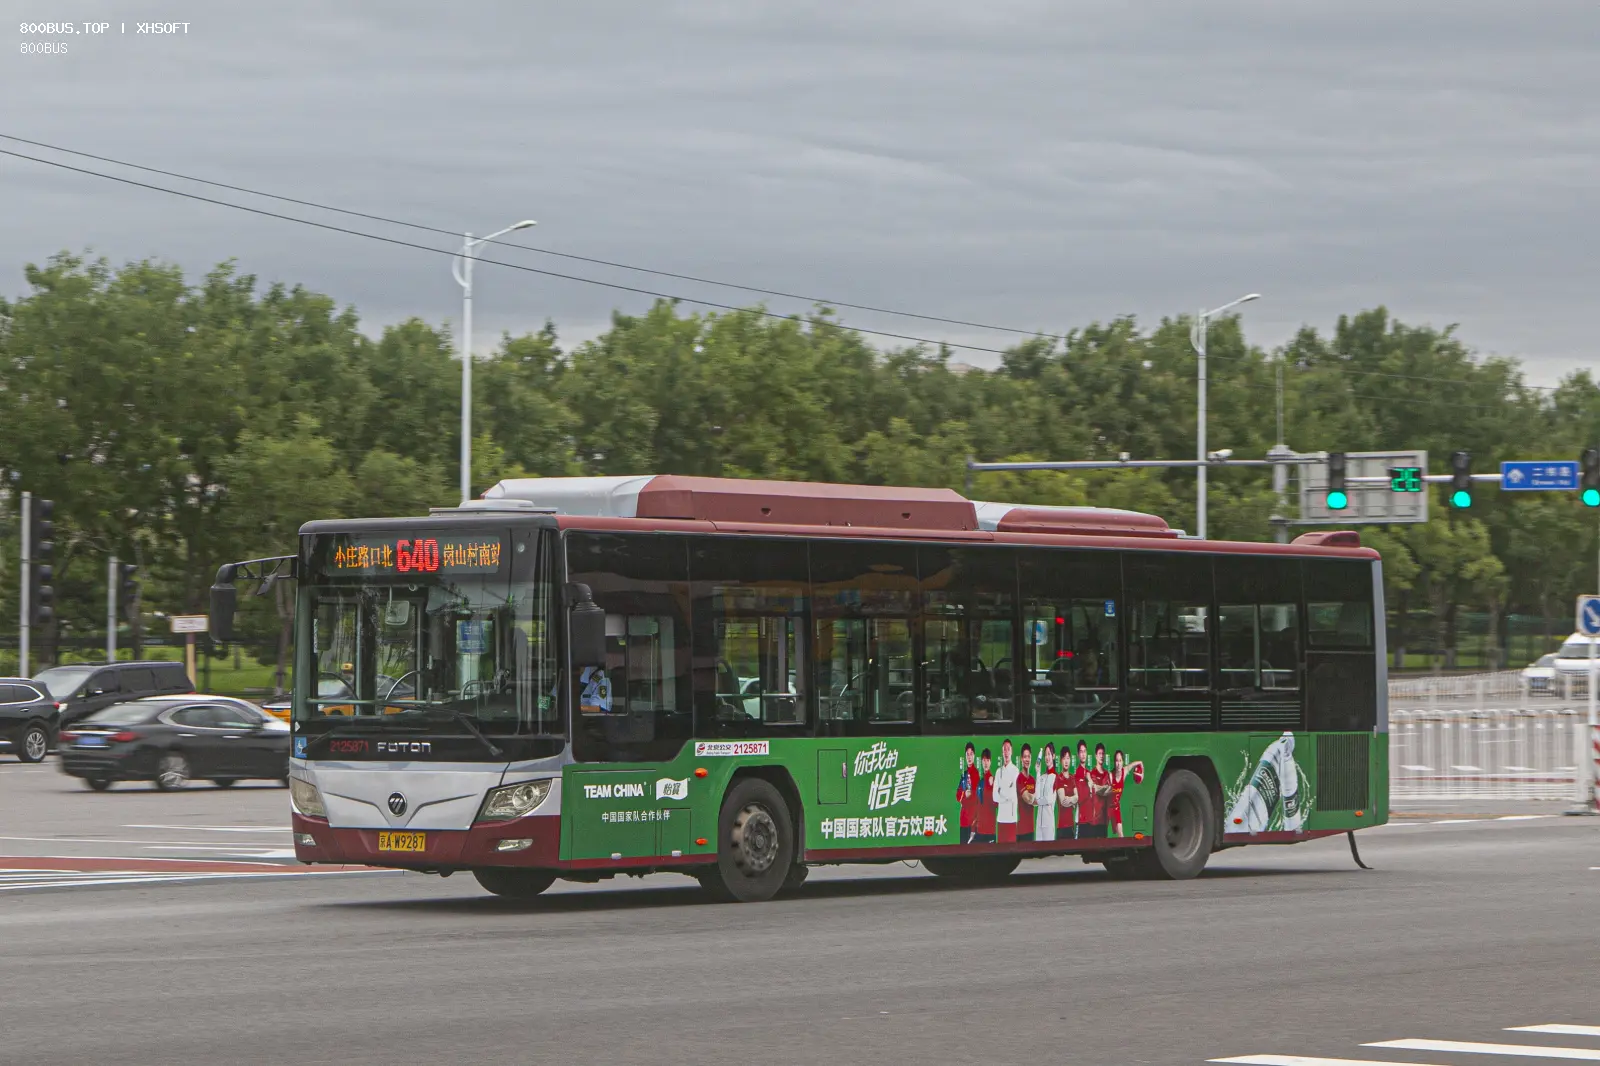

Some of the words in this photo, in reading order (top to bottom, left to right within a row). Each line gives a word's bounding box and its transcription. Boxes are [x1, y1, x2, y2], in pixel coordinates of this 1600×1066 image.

[396, 539, 439, 572] 640
[329, 740, 369, 753] 2125871
[377, 742, 431, 753] FOTON
[733, 743, 767, 754] 2125871
[853, 741, 899, 777] 你我的
[584, 784, 612, 798] TEAM
[613, 783, 644, 797] CHINA
[601, 809, 671, 823] 中国国家队合作伙伴
[820, 814, 948, 840] 中国国家队官方饮用水
